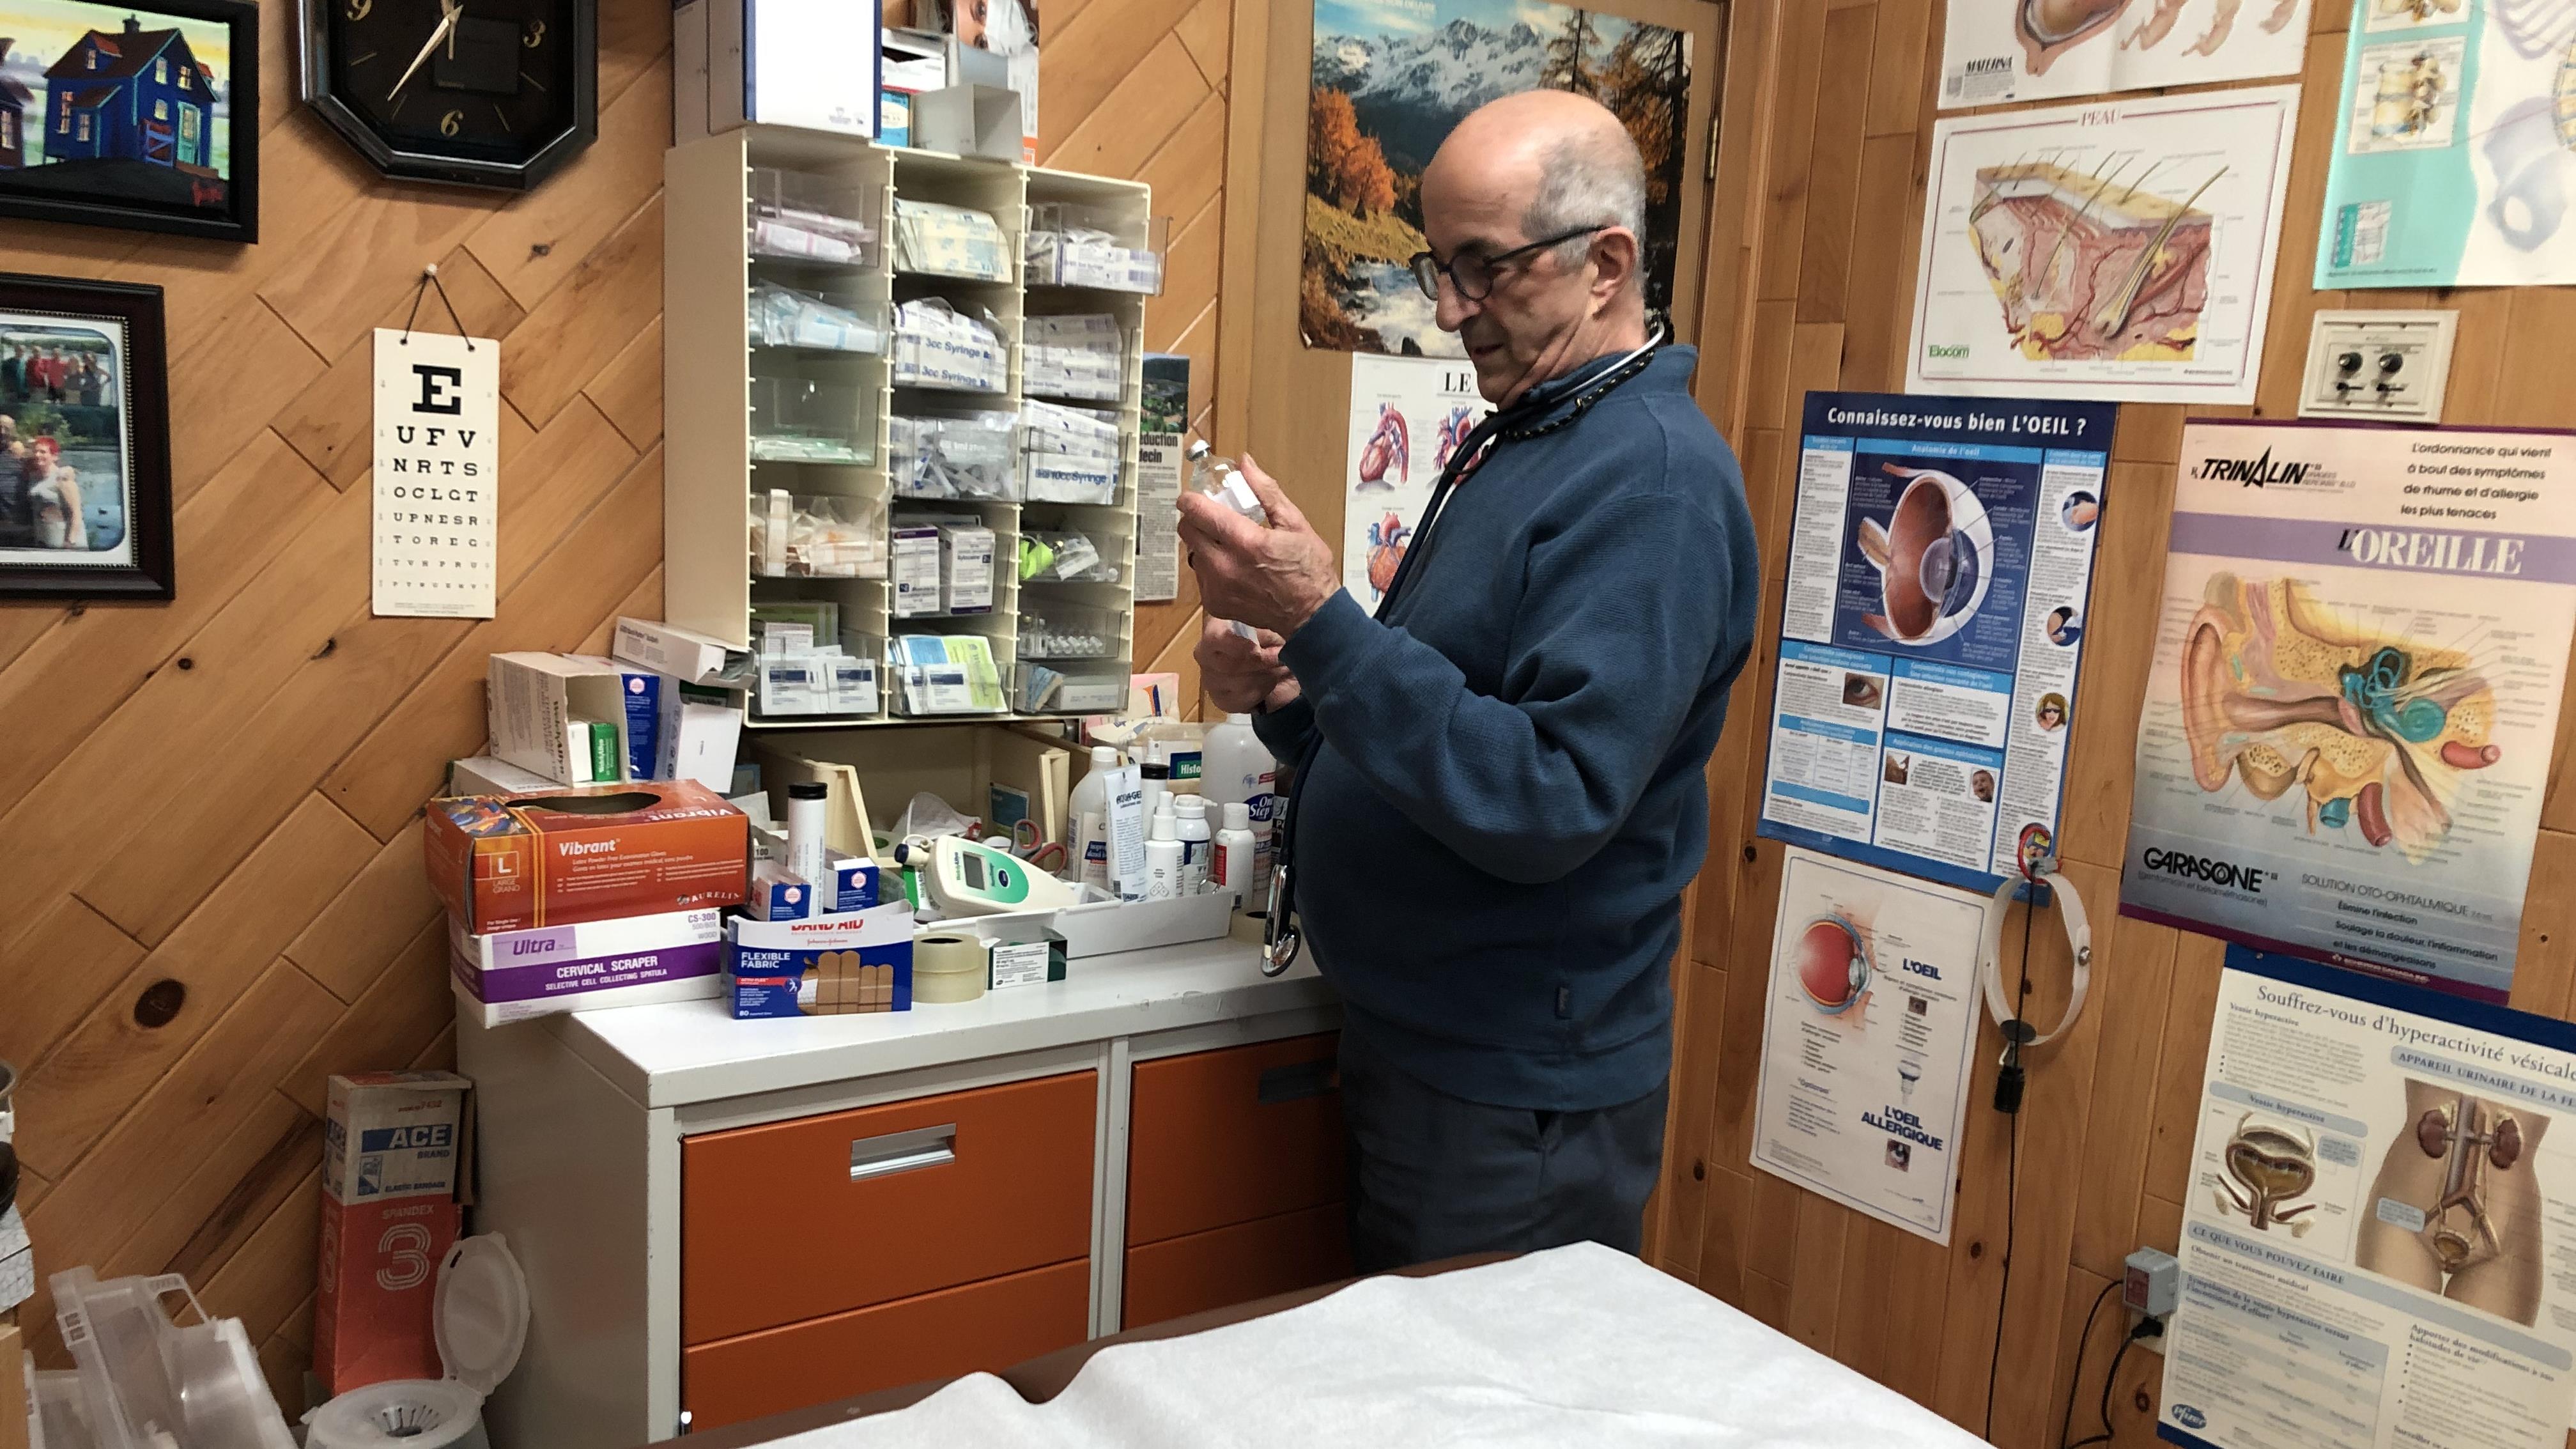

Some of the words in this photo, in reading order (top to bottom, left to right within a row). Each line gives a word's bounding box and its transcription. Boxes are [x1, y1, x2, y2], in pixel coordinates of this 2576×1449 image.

[523, 19, 546, 48] 3
[440, 109, 464, 137] 6
[2081, 108, 2121, 127] PEAU
[945, 341, 980, 359] Syringe
[412, 364, 461, 415] E
[1445, 372, 1471, 392] LE
[1827, 407, 1963, 430] Connaissez-vous
[1968, 412, 2005, 432] bien
[2012, 414, 2071, 435] L'OEIL
[2412, 442, 2495, 456] L'ordonnance
[2497, 446, 2518, 458] qui
[2520, 447, 2552, 458] vient
[2419, 464, 2448, 475] bout
[2449, 465, 2472, 477] des
[2474, 467, 2546, 480] symptômes
[2403, 483, 2421, 495] de
[2423, 484, 2462, 497] rhume
[2464, 486, 2479, 497] et
[2400, 504, 2418, 515] les
[2419, 505, 2444, 517] plus
[2447, 507, 2497, 520] tenaces
[2338, 528, 2526, 575] L'OREILLE
[1249, 804, 1270, 819] Step
[558, 839, 617, 857] Vibrant
[498, 857, 512, 874] L
[2143, 847, 2264, 894] GARASONE
[2301, 872, 2356, 895] SOLUTION
[687, 912, 717, 924] CS-300
[512, 938, 556, 957] Ultra
[741, 951, 791, 961] FLEXIBLE
[556, 962, 607, 979] CERVICAL
[610, 955, 658, 972] SCRAPER
[741, 960, 780, 969] FABRIC
[1902, 957, 1943, 981] L'OEIL
[545, 979, 580, 992] SELECTIVE
[581, 977, 598, 987] CELL
[599, 972, 638, 984] COLLECTING
[640, 968, 668, 979] SPATULA
[2256, 984, 2367, 1027] Souffrez-vous
[2372, 1014, 2505, 1062] d'hyperactivité
[2398, 1052, 2453, 1074] APPAREIL
[2457, 1067, 2517, 1091] URINAIRE
[2520, 1083, 2536, 1097] DE
[2541, 1089, 2557, 1102] LA
[1885, 1104, 1924, 1130] L'OEIL
[388, 1126, 447, 1149] ACE
[1860, 1111, 1944, 1152] ALLERGIQUE
[417, 1149, 451, 1159] BRAND
[376, 1223, 432, 1291] 3
[2192, 1225, 2206, 1237] CE
[2209, 1230, 2232, 1247] QUE
[2234, 1238, 2264, 1257] VOUS
[2265, 1250, 2311, 1273] POUVEZ
[2312, 1263, 2345, 1284] FAIRE
